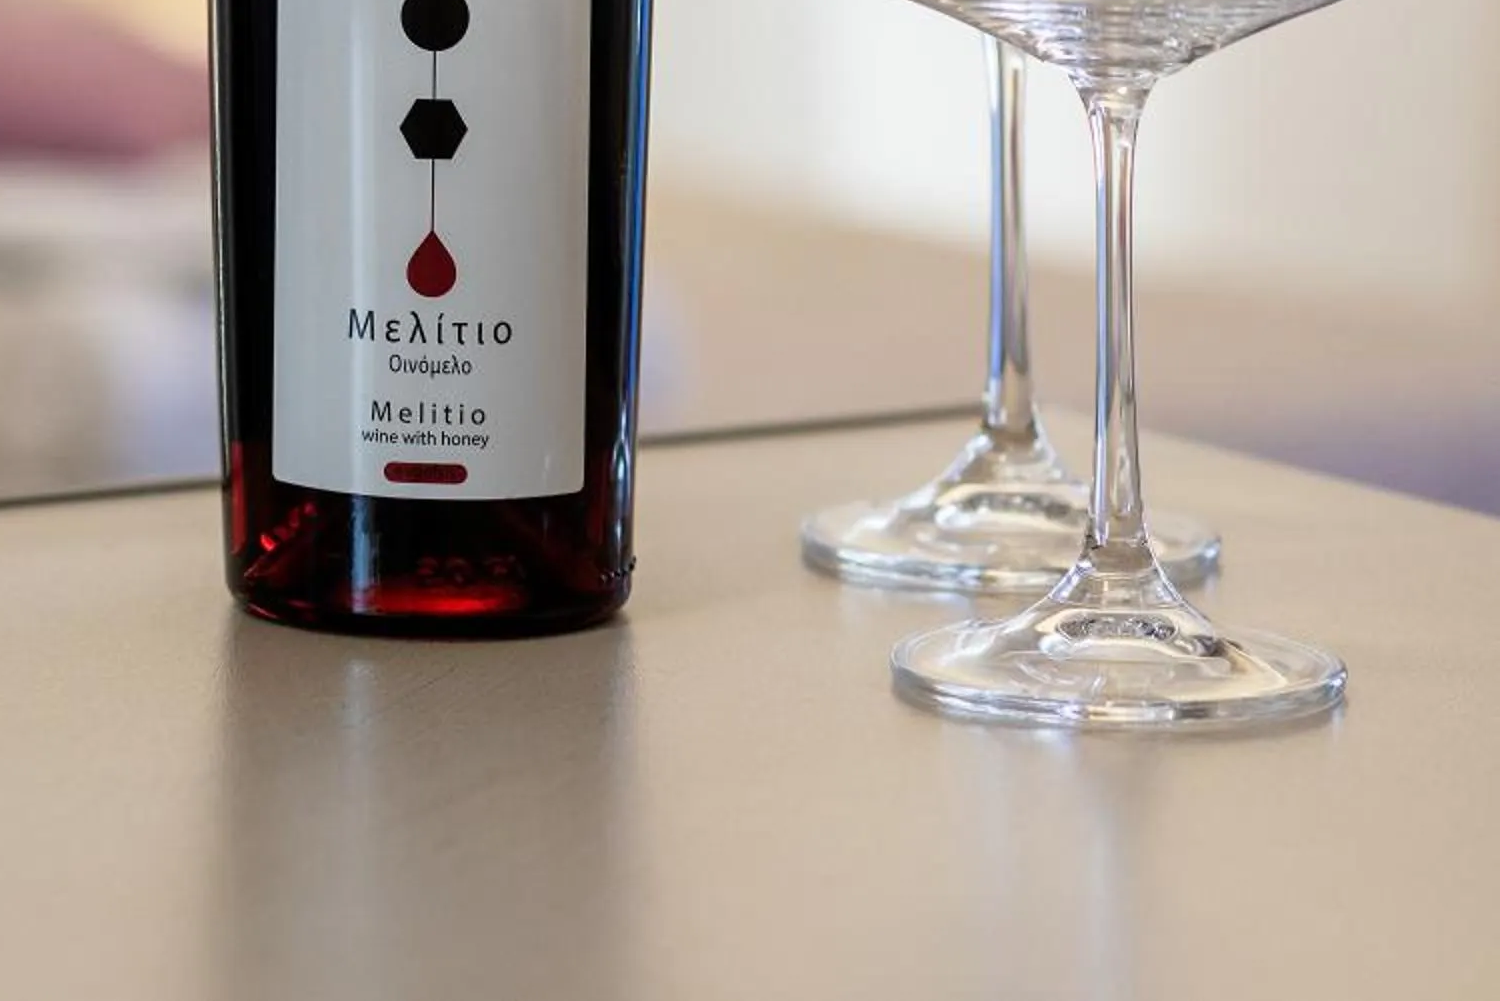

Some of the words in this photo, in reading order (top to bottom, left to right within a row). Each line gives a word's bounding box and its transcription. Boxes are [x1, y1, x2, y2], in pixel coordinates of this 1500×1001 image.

[348, 308, 513, 346] Μελίτιο
[388, 353, 473, 379] Οινόμελο
[371, 400, 486, 425] Melitio
[361, 428, 399, 444] wine
[402, 430, 437, 446] with
[441, 430, 490, 449] honey
